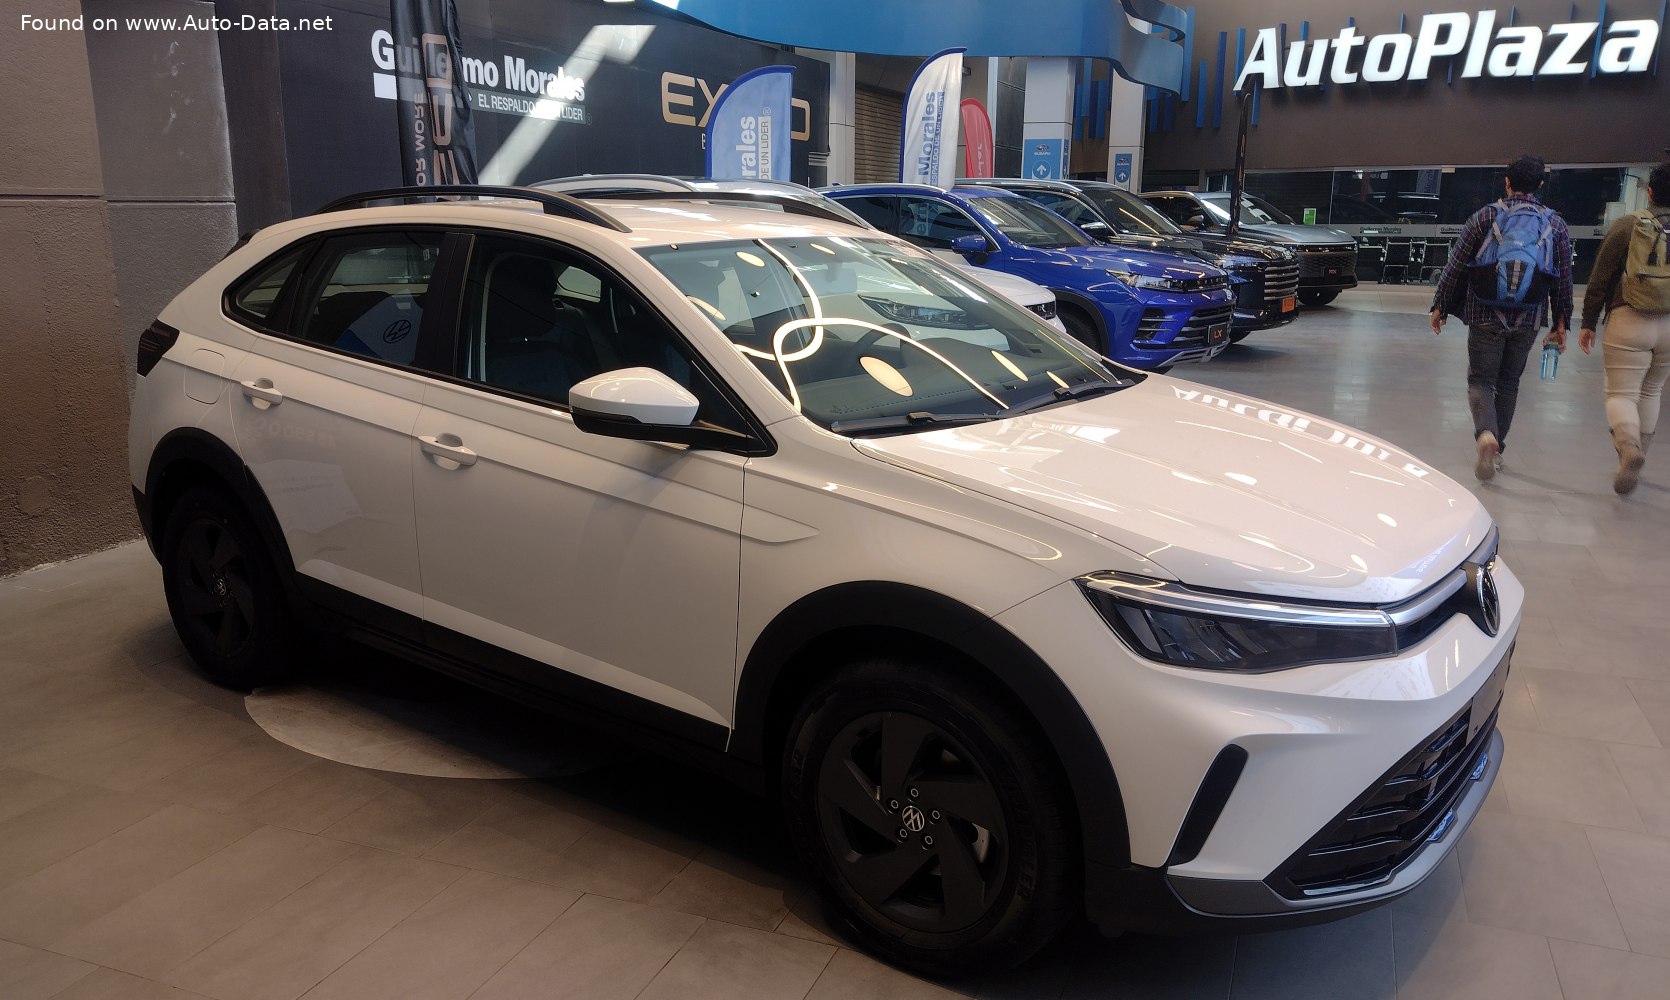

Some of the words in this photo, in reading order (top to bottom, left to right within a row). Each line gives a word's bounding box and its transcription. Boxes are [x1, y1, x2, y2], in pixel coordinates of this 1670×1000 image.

[1233, 9, 1660, 92] AutoPlaza
[478, 93, 490, 108] EL
[661, 71, 811, 142] EXD
[736, 116, 757, 178] rales
[760, 121, 769, 149] LIDER
[918, 92, 936, 176] Morales
[760, 151, 769, 165] UN
[1214, 329, 1223, 338] LX
